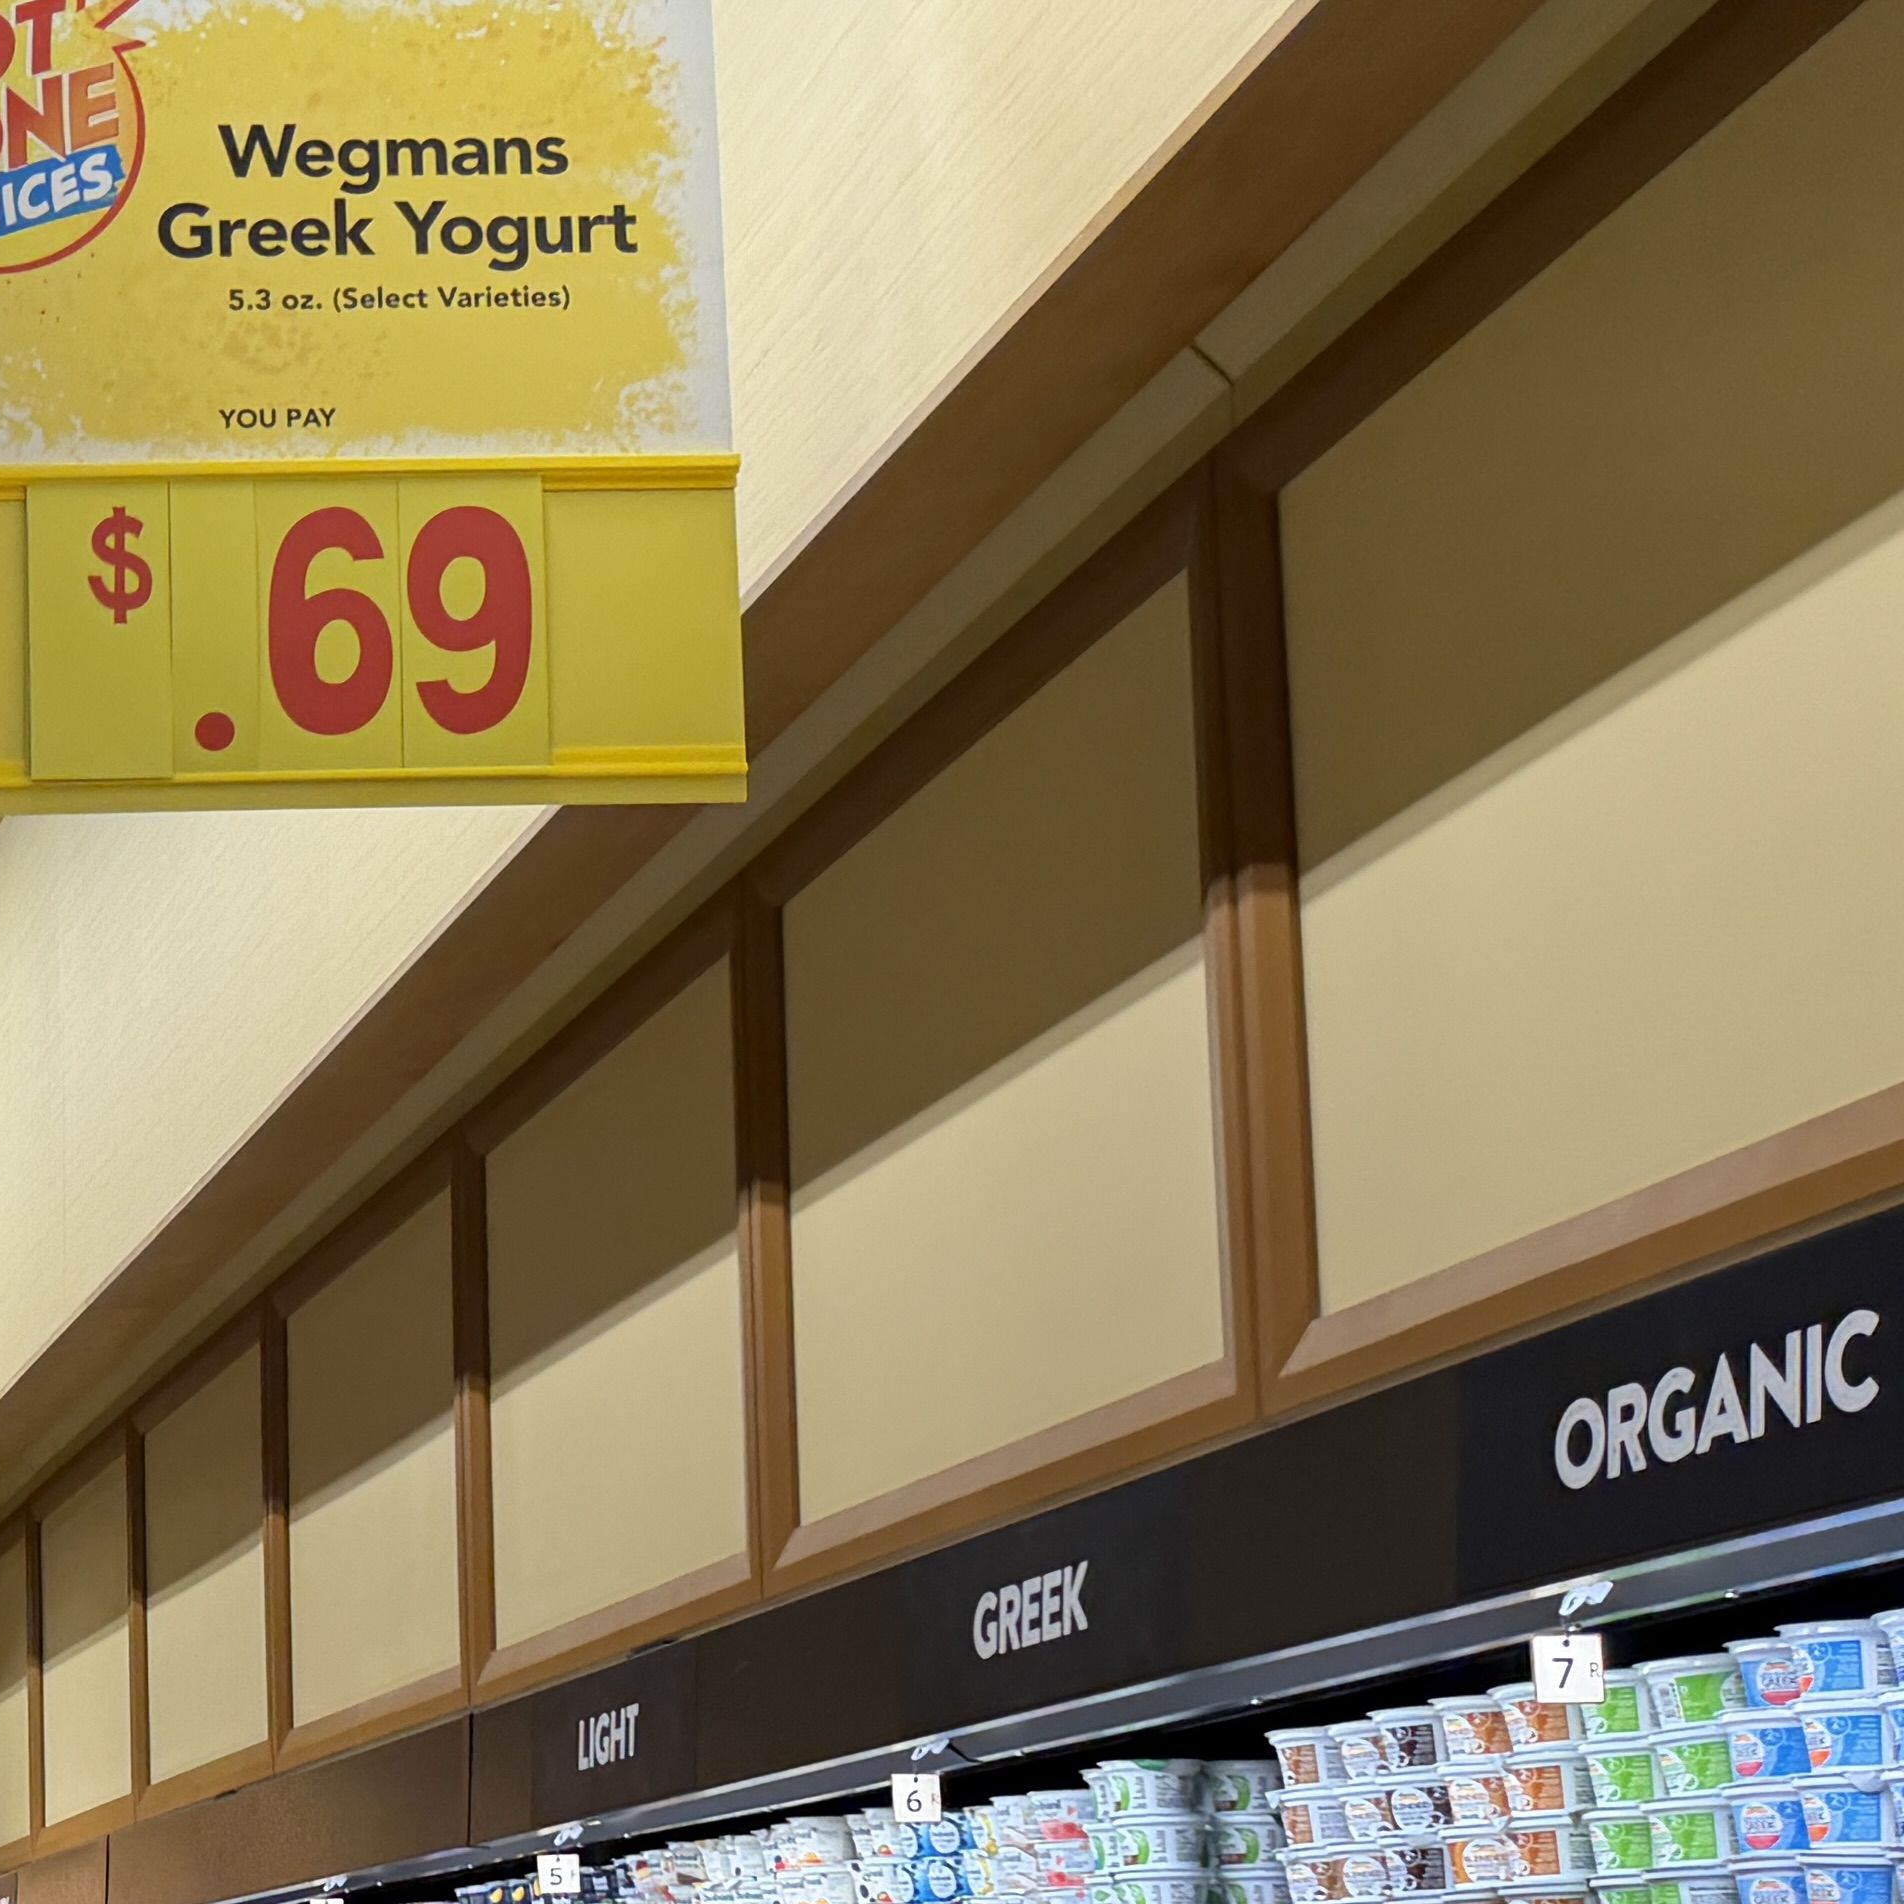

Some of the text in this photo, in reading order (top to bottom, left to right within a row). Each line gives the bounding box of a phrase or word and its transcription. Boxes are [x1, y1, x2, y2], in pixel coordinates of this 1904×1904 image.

[219, 123, 568, 189] Wegmans
[158, 198, 637, 272] Greek Yogurt
[227, 284, 572, 315] 5.3 oz. (Select Varieties)
[219, 408, 337, 430] YOU PAY
[1553, 1308, 1881, 1491] ORGANIC
[973, 1559, 1089, 1661] GREEK
[1551, 1657, 1574, 1689] 7
[577, 1703, 639, 1771] LIGHT
[906, 1792, 922, 1812] 6
[550, 1867, 563, 1886] 5
